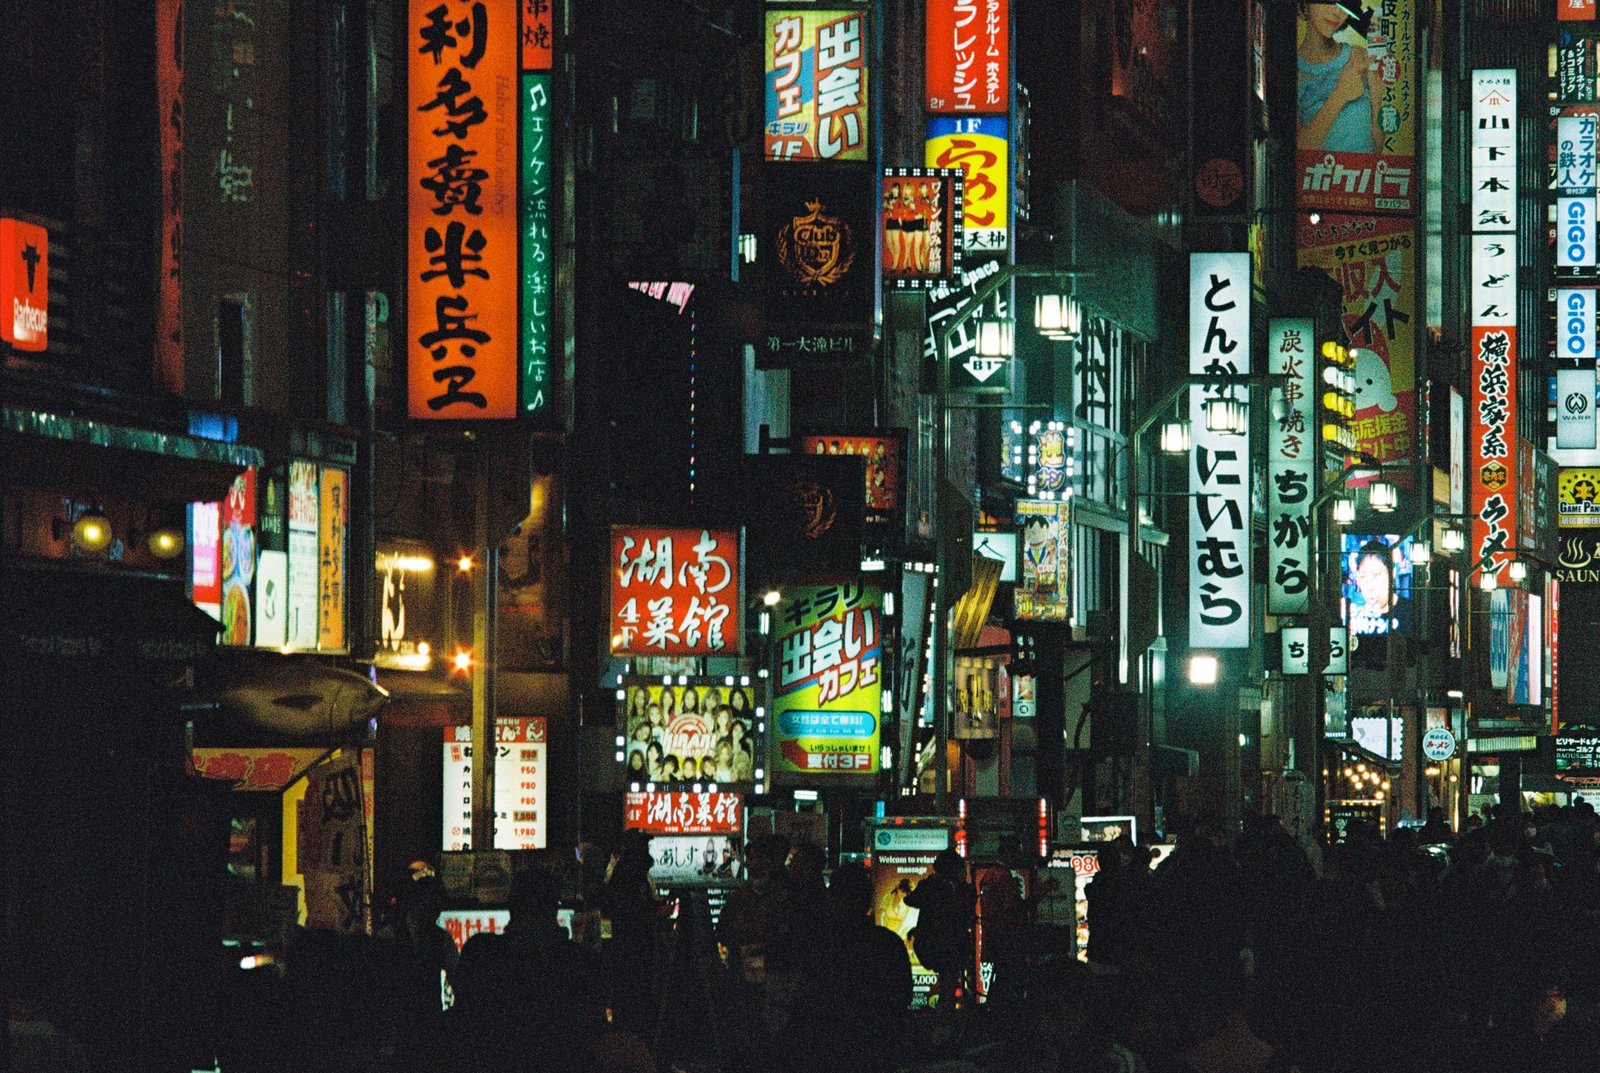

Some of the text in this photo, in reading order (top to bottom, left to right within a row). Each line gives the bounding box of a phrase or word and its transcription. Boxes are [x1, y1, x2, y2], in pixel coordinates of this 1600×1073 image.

[774, 16, 802, 119] カフェ
[817, 16, 861, 160] 出会い
[768, 122, 808, 135] キラリ
[954, 118, 982, 133] 1F
[1579, 118, 1595, 186] カラオケ
[1302, 154, 1411, 196] ポケパラ
[1560, 140, 1576, 186] の鉄人
[967, 231, 1006, 248] 天神
[1567, 201, 1586, 262] GiGO
[1567, 293, 1586, 354] GiGO
[1479, 330, 1510, 459] 横浜家系
[1196, 273, 1244, 626] とんかにいむら
[1559, 501, 1582, 514] GAME
[780, 608, 876, 690] 出会い
[817, 655, 878, 708] カフェ
[879, 854, 907, 864] Welcom
[908, 855, 916, 864] to
